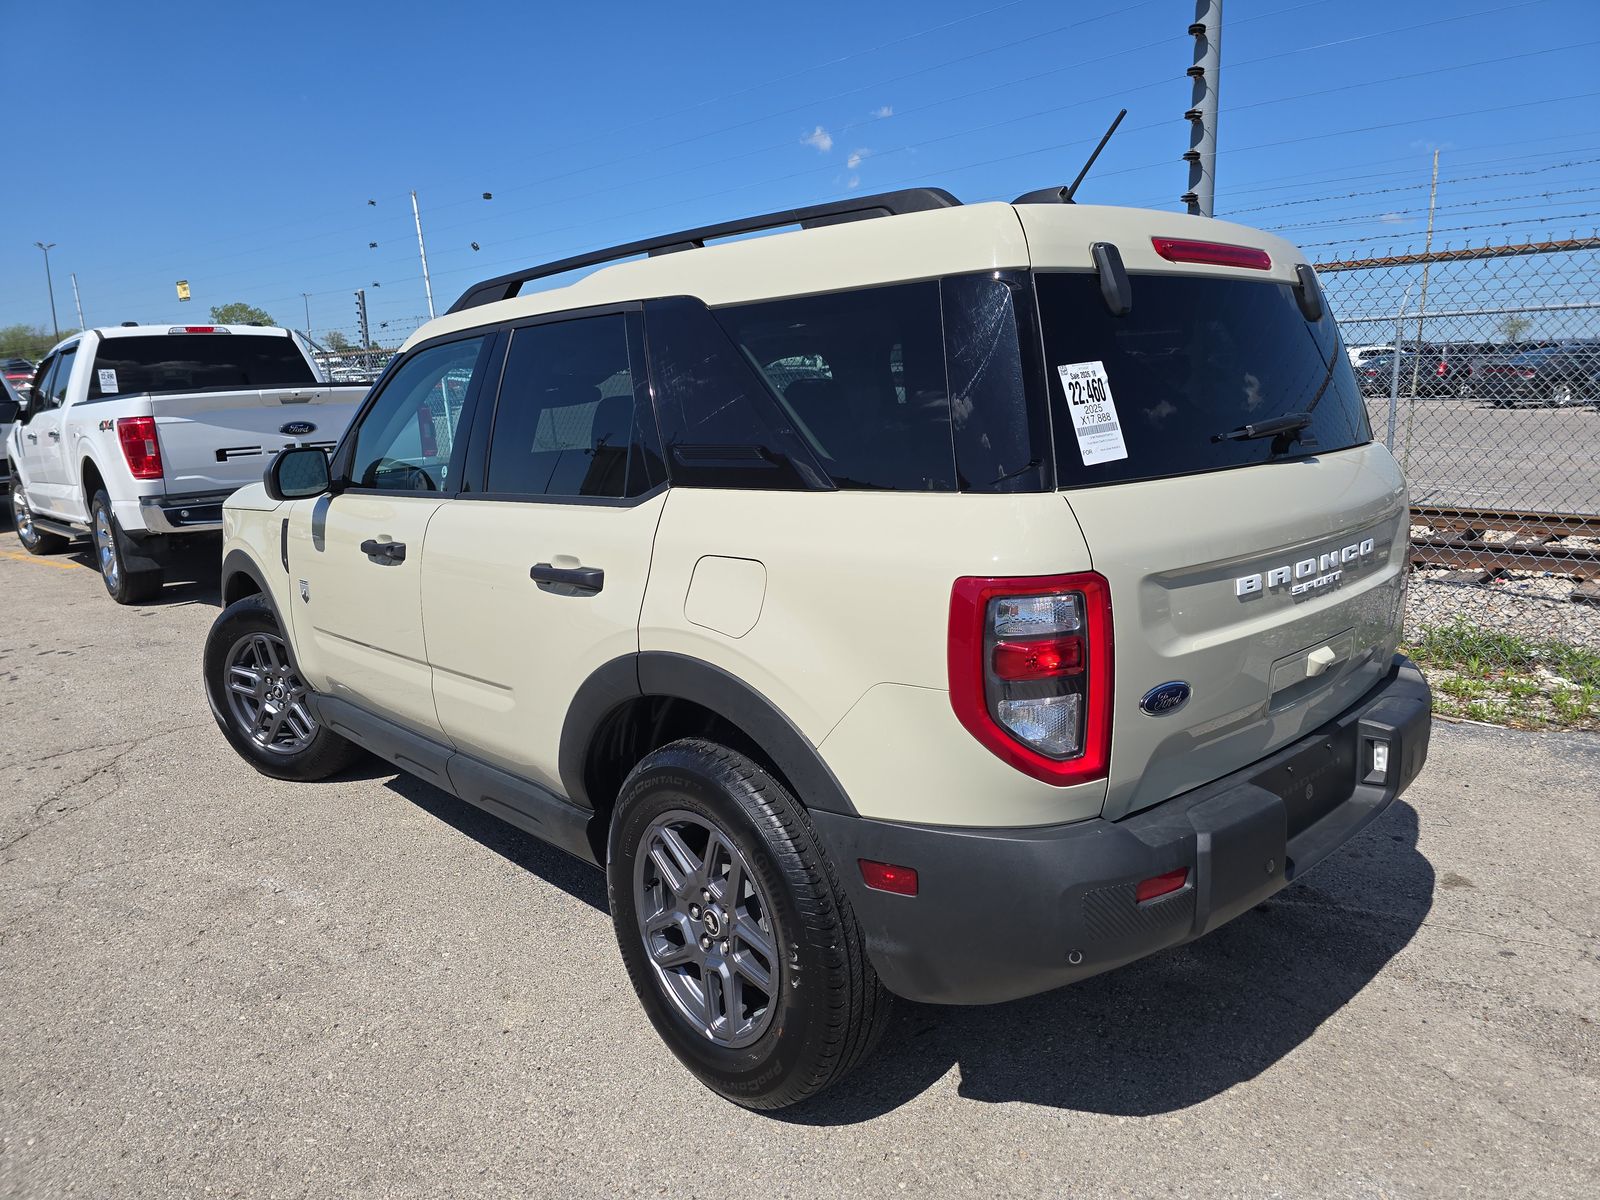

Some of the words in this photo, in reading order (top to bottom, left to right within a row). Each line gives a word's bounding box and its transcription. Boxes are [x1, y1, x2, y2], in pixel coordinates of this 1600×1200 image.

[1068, 378, 1106, 405] 22:460
[1084, 404, 1103, 415] 2025
[1235, 538, 1374, 596] BRONCO
[1291, 570, 1343, 596] SPORT
